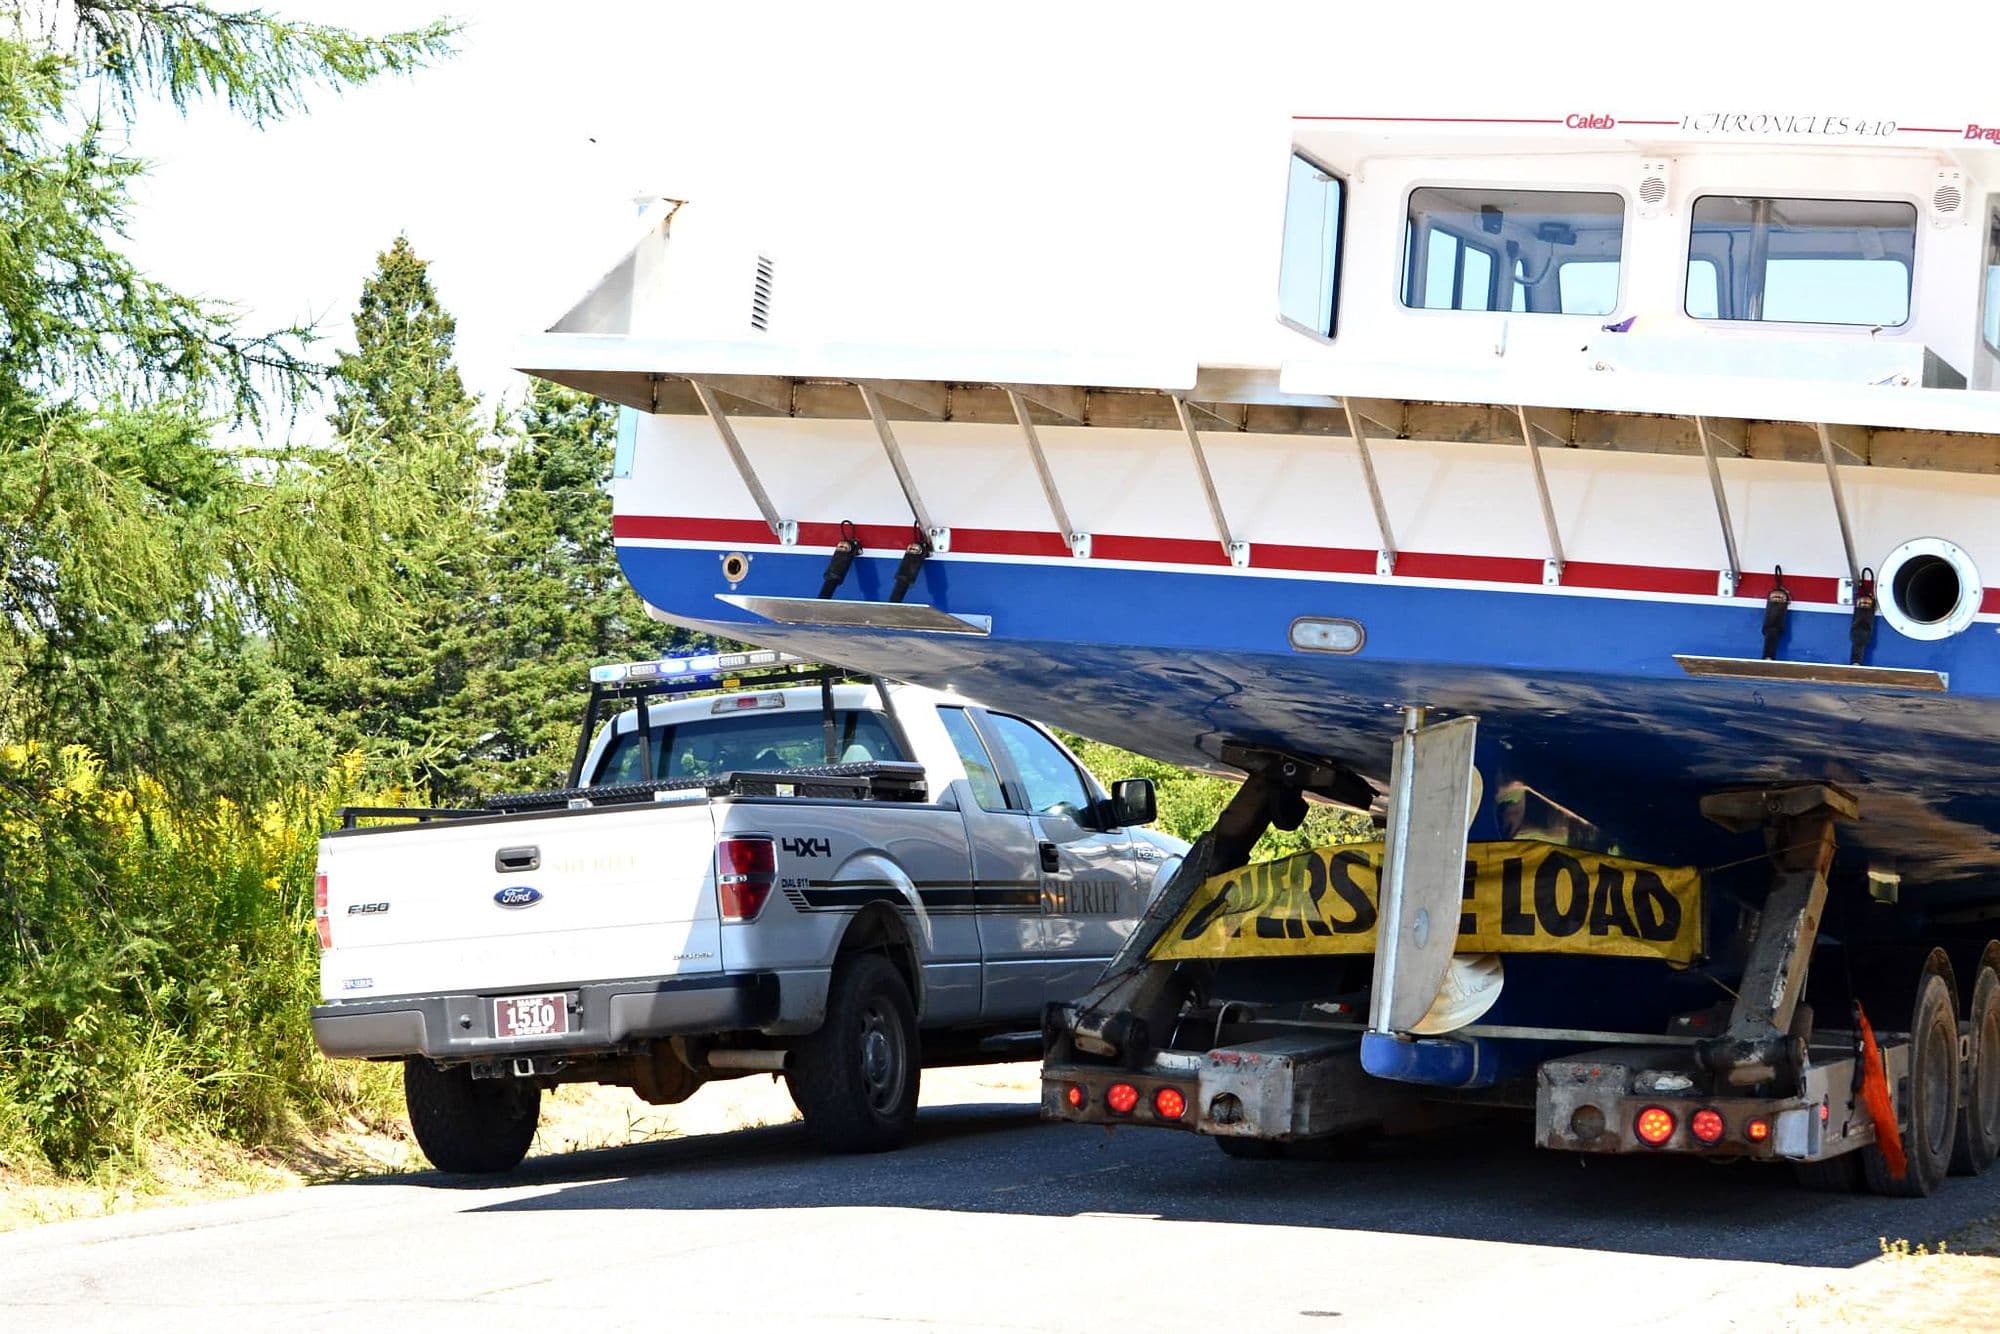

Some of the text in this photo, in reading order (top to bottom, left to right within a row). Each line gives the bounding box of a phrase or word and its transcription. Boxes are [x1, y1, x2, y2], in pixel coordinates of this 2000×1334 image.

[1566, 113, 1615, 129] Caleb
[1694, 113, 1849, 135] CHRONICLES
[502, 888, 532, 904] Ford
[1041, 880, 1121, 914] SHERIFF
[1181, 850, 1682, 942] OVERS LOAD
[506, 1004, 556, 1029] 1510
